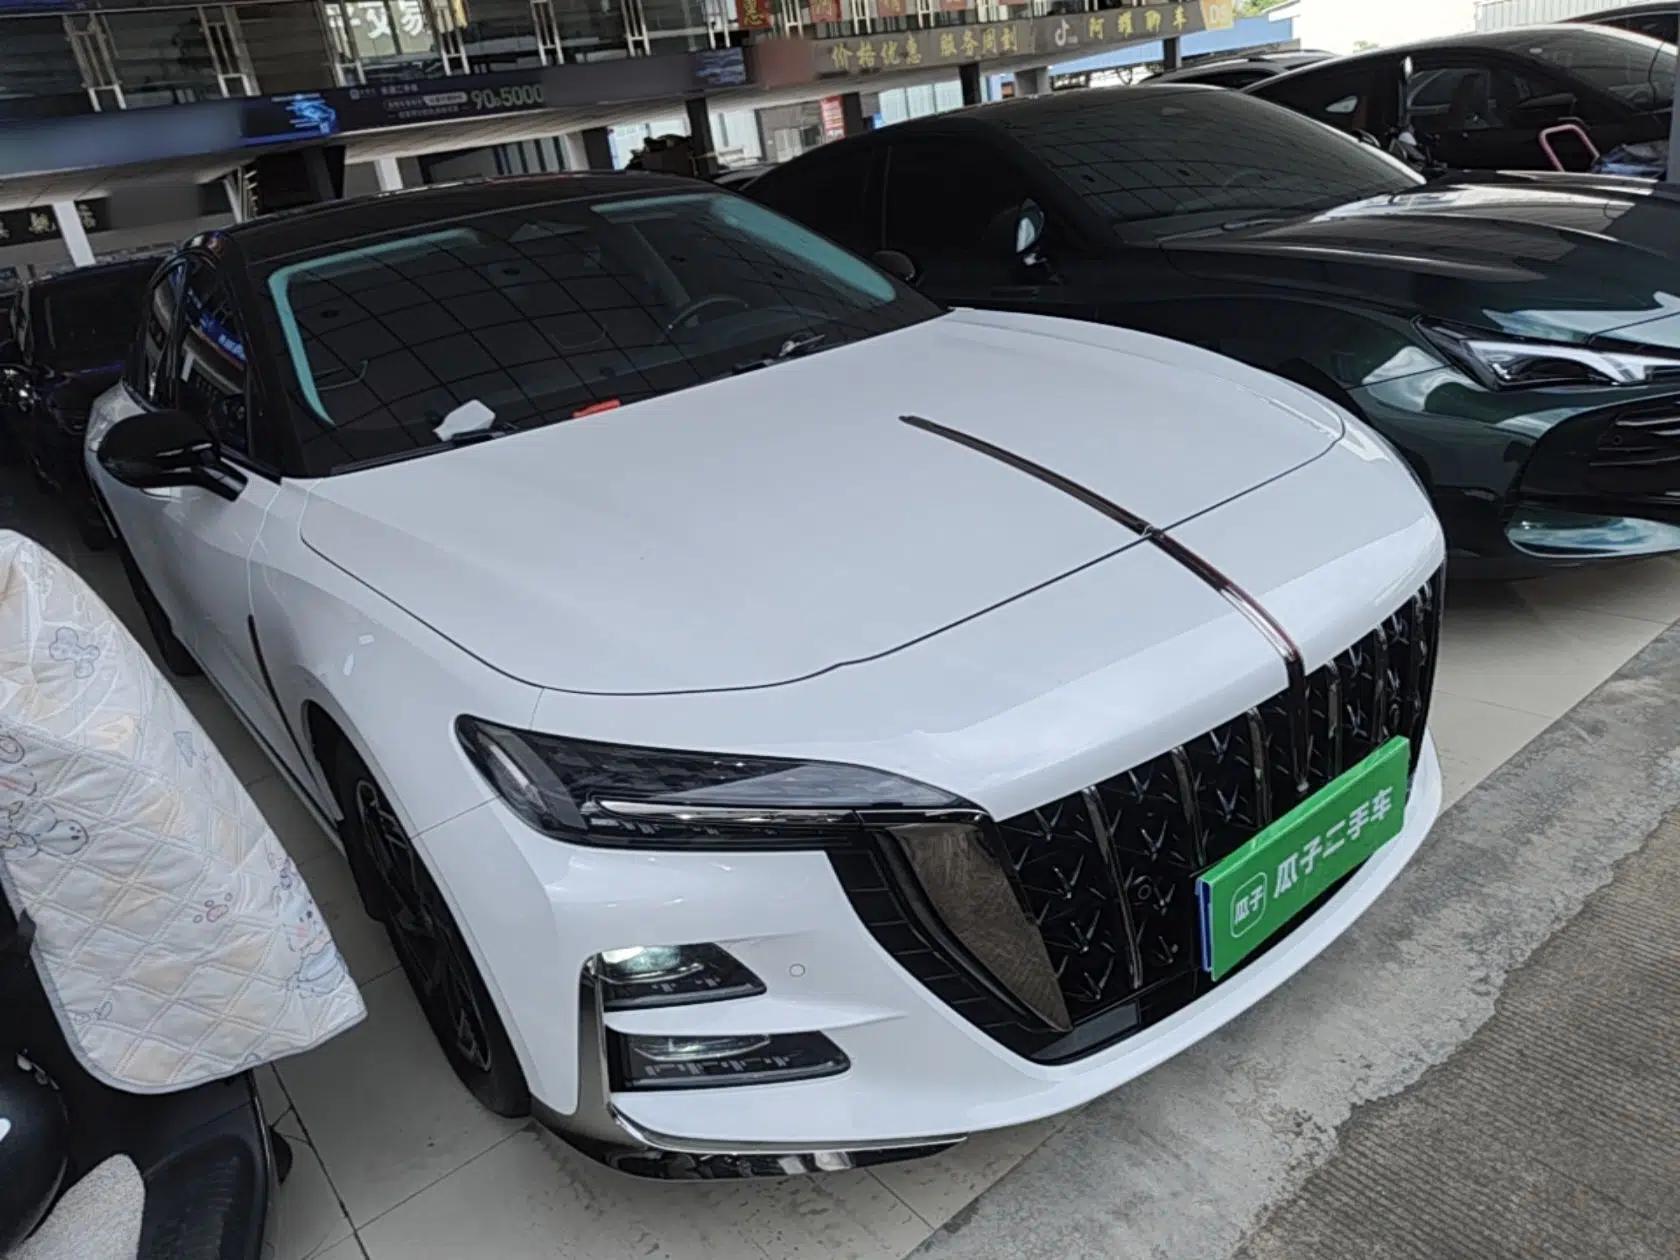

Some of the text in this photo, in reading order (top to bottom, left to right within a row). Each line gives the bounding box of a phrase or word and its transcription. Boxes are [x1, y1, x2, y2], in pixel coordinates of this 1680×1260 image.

[831, 24, 1018, 69] 价格优惠 服务周到
[1234, 786, 1393, 925] 瓜子 瓜子二手车
